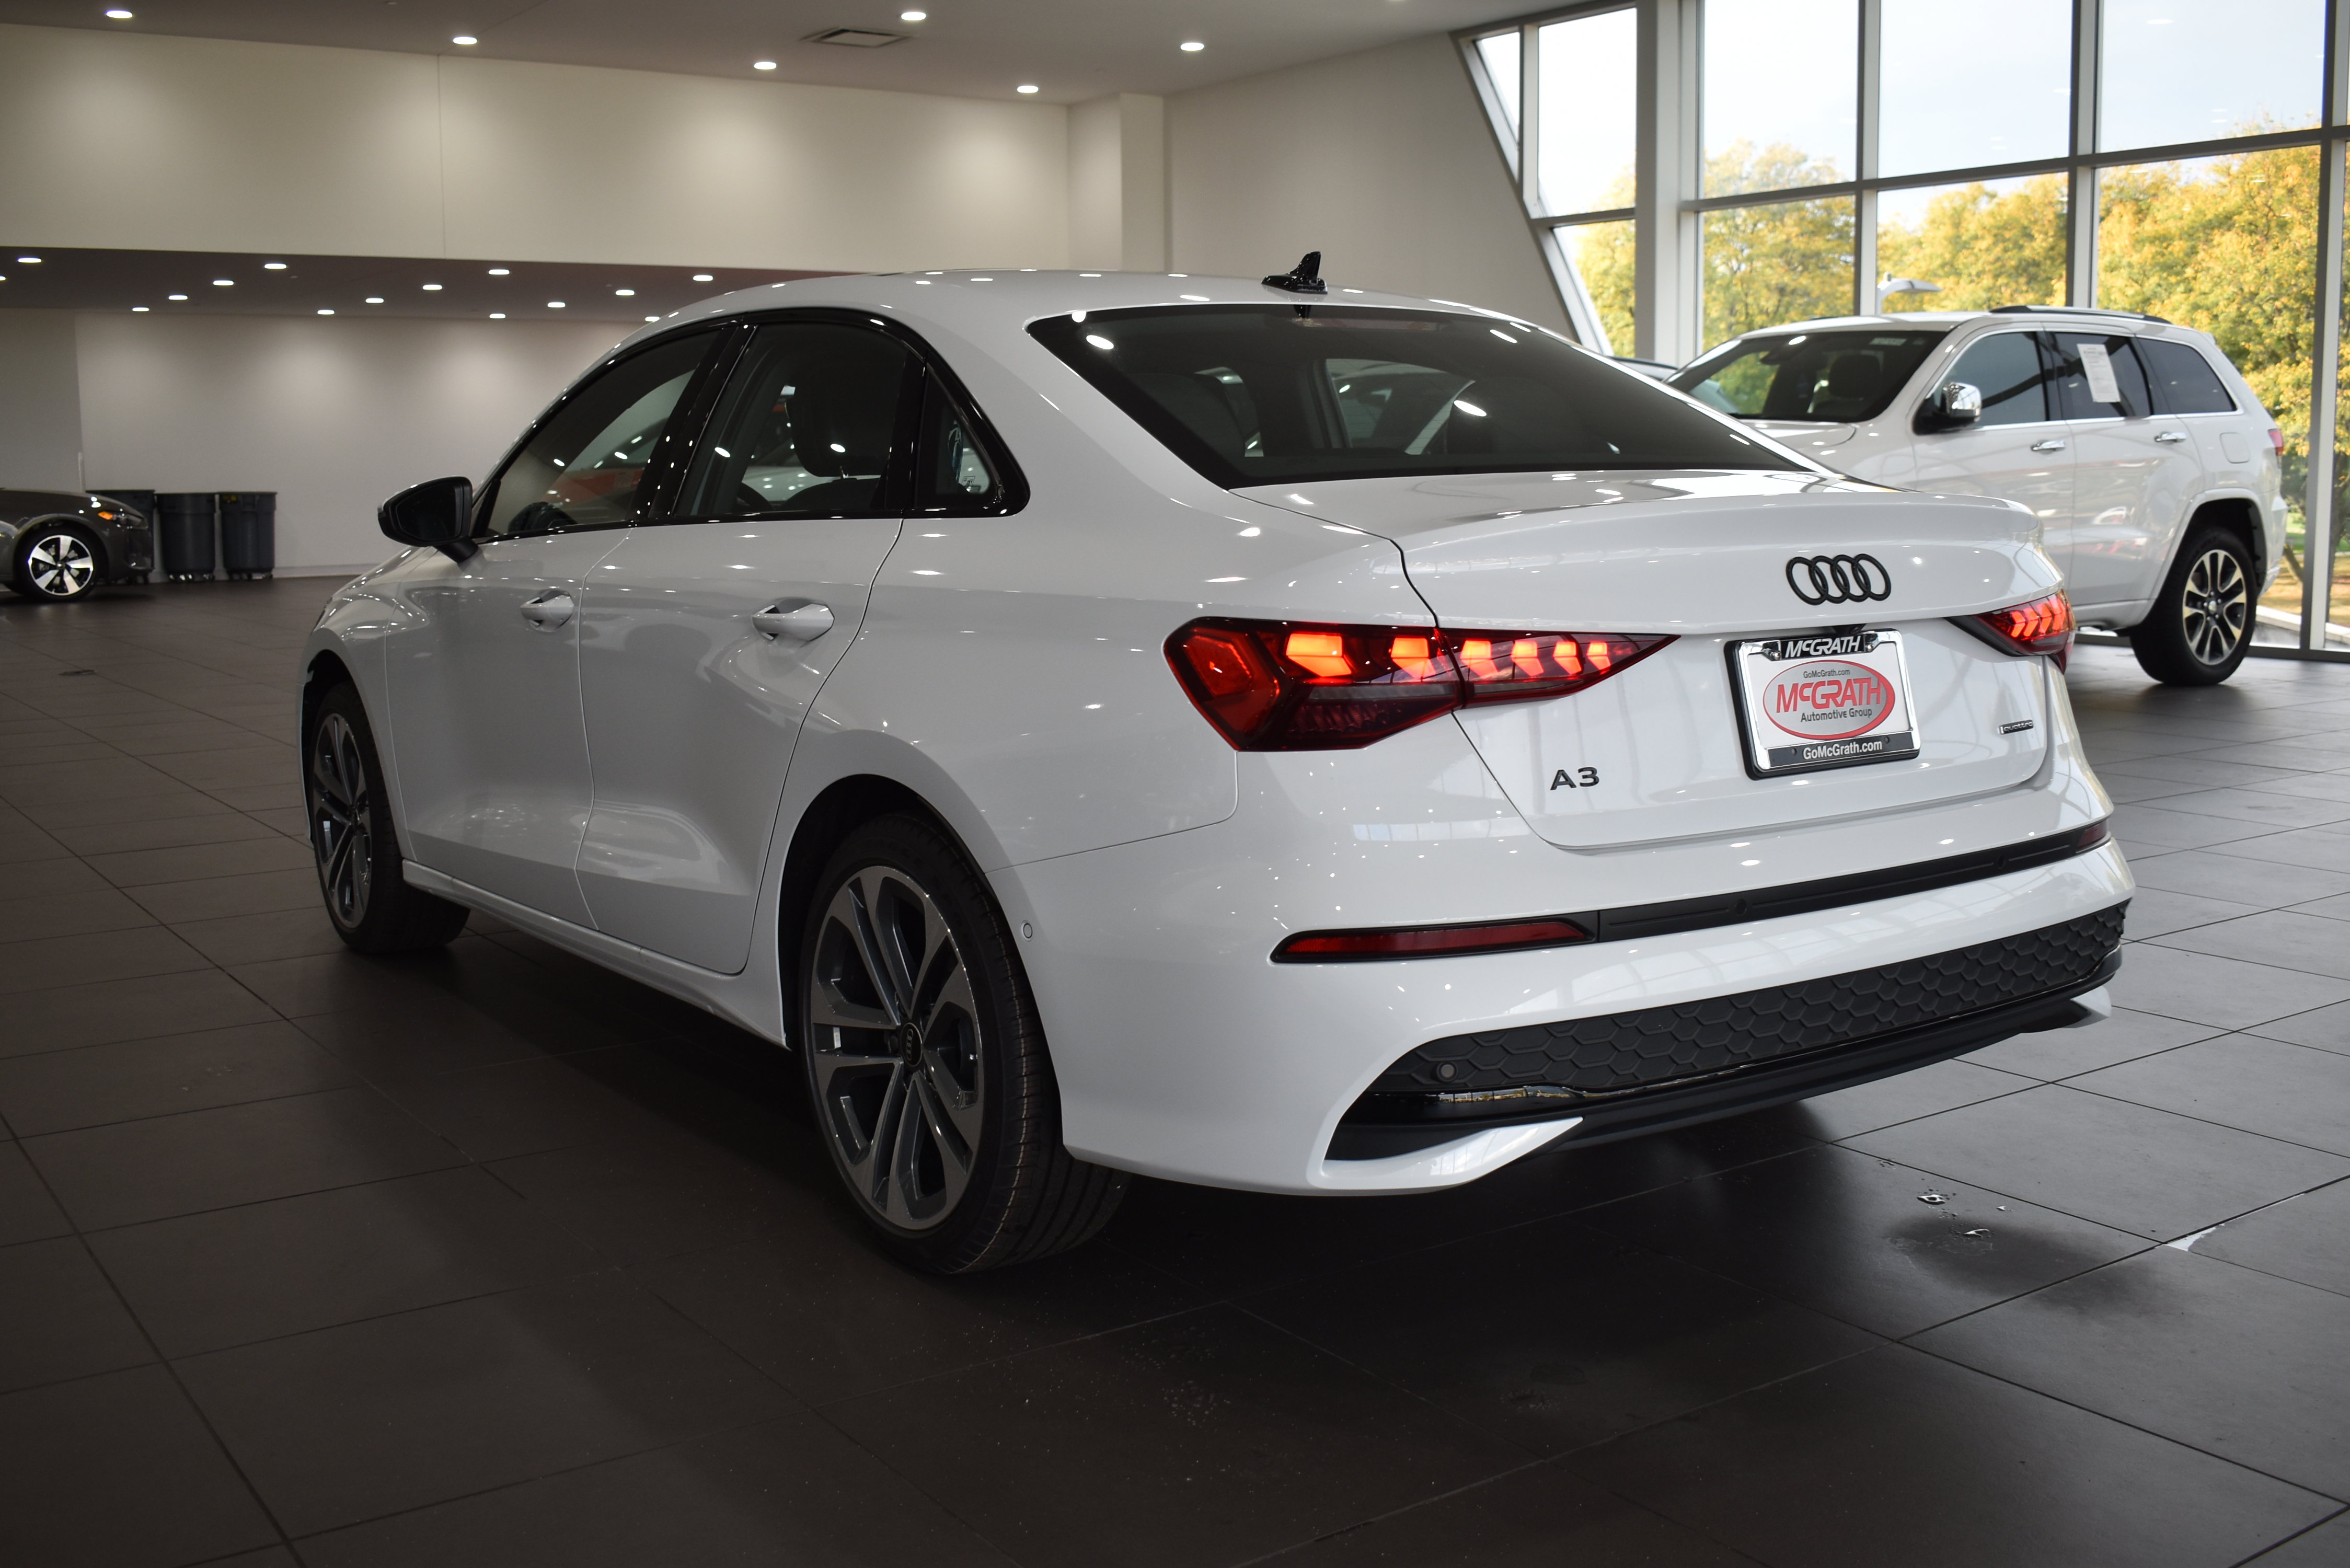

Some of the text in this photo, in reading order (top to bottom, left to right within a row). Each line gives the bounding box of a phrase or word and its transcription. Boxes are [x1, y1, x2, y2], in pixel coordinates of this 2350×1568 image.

[1803, 669, 1850, 678] GoMcGrath.com
[1801, 708, 1872, 722] Automotive Group
[1803, 740, 1882, 760] GoMcGrath.com
[1550, 767, 1599, 791] A3
